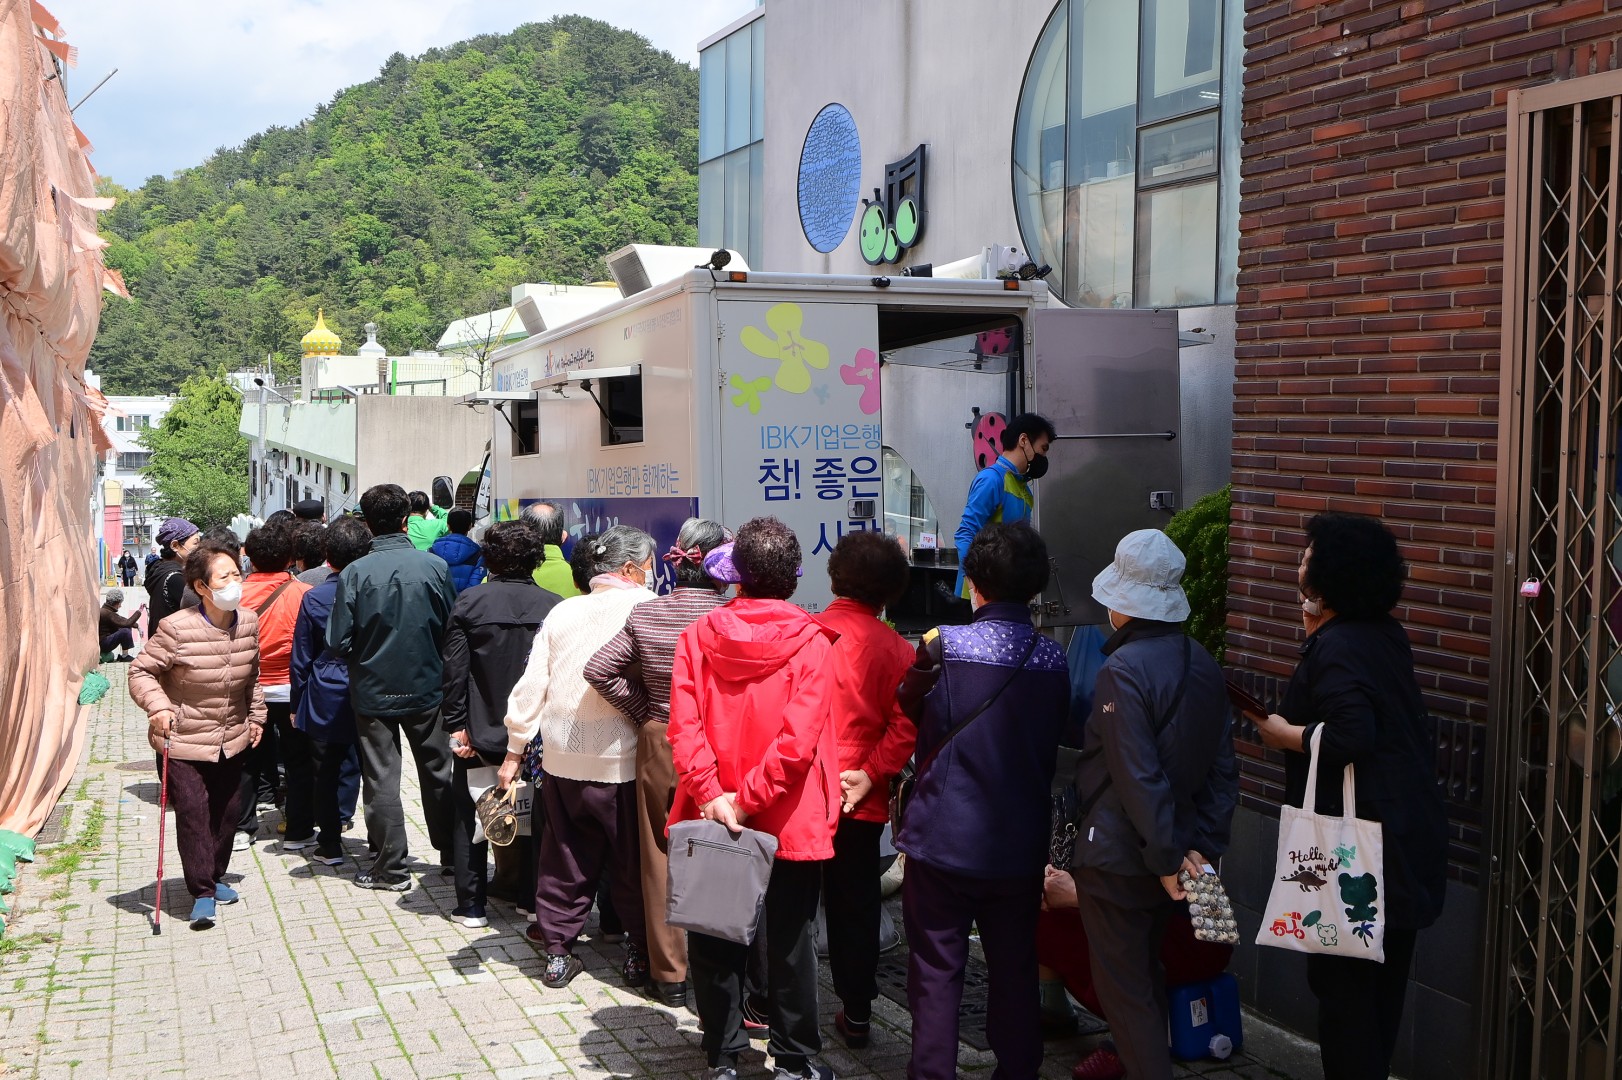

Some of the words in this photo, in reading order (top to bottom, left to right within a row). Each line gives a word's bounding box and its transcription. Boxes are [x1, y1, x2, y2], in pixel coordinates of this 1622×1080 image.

[760, 424, 881, 450] IBK기업은행
[587, 465, 640, 496] IBK기업은행과
[642, 462, 680, 495] 함께하는
[757, 457, 801, 502] 참!
[812, 456, 882, 500] 좋은
[1288, 846, 1327, 865] Hello,
